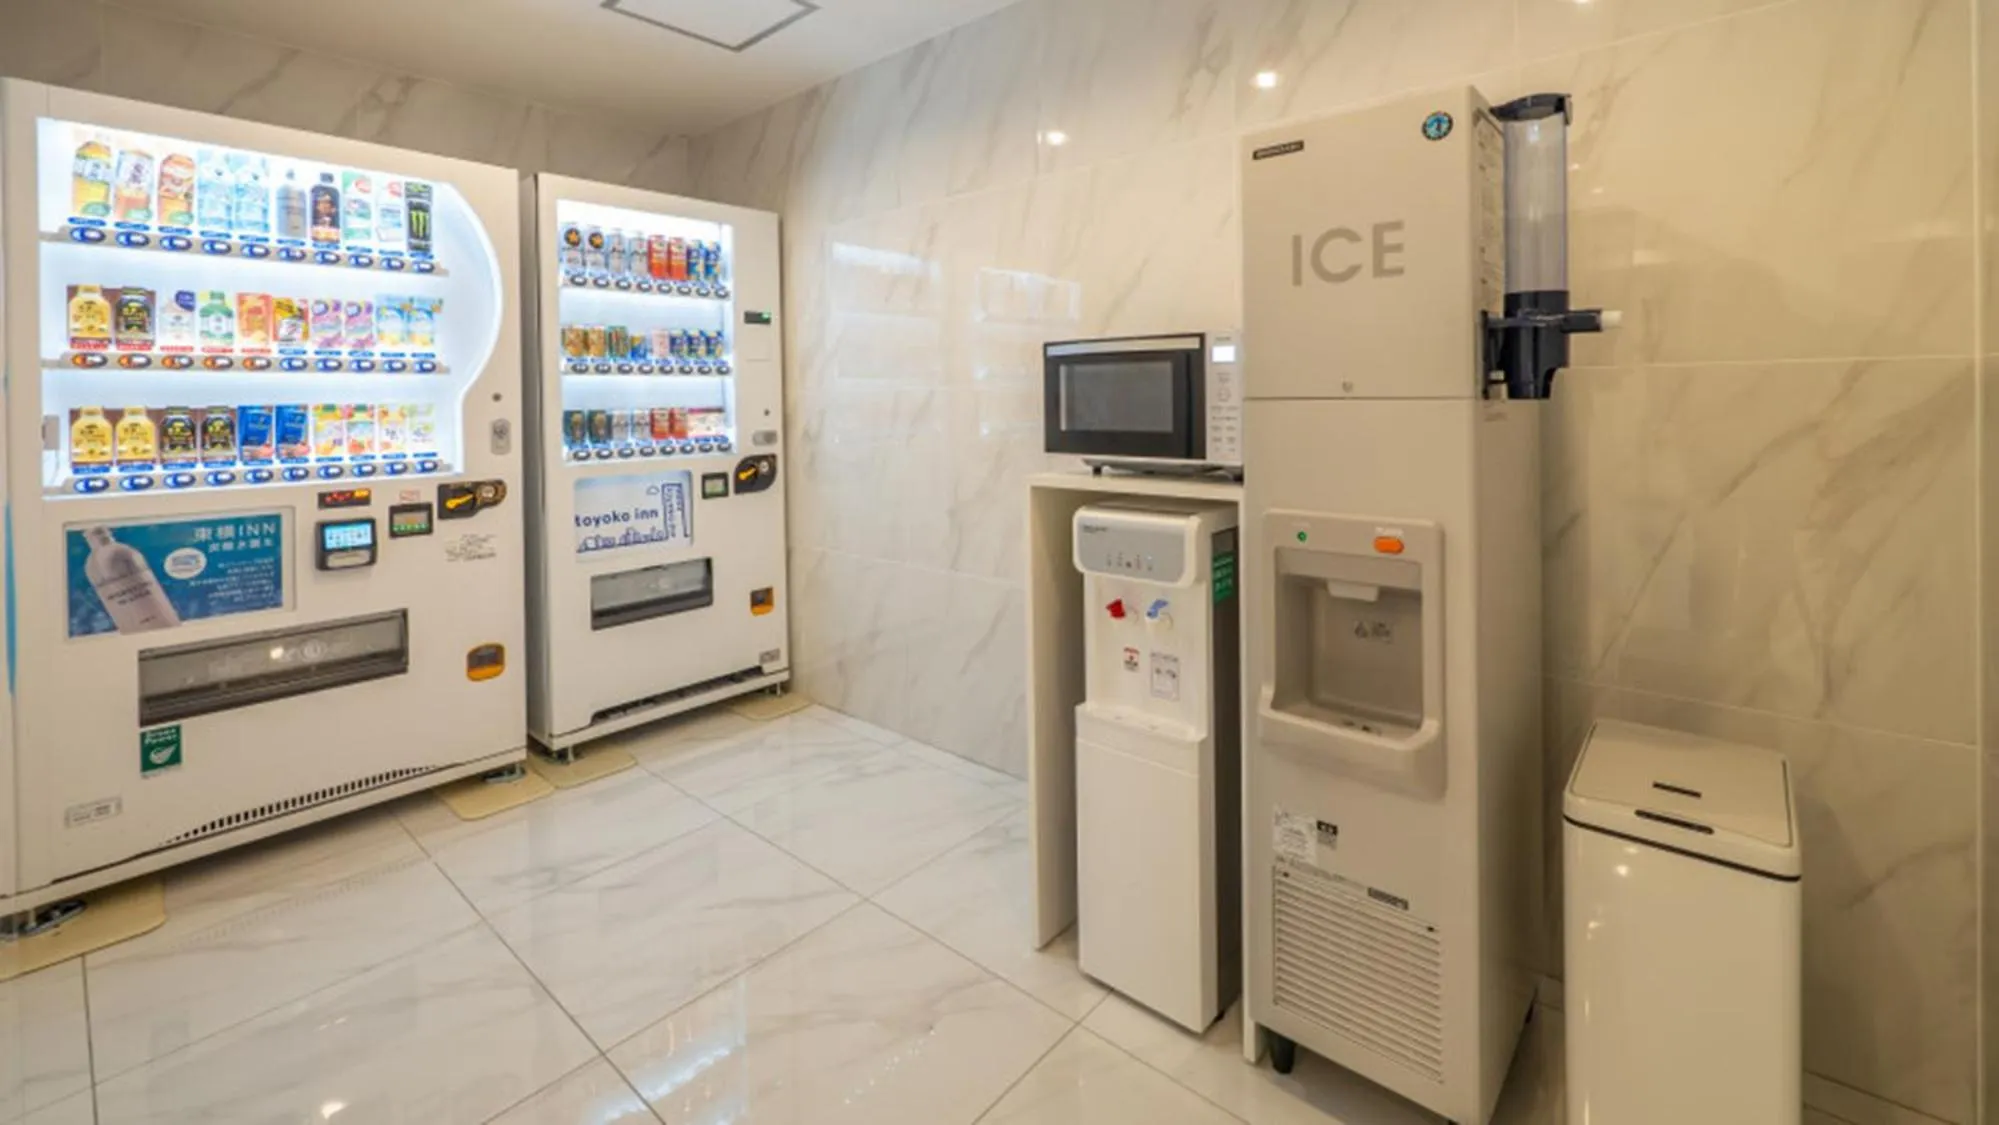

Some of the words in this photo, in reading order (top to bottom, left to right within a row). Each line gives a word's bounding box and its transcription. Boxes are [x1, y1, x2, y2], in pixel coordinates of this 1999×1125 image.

[1291, 219, 1405, 287] ICE
[575, 509, 630, 529] toyoko
[634, 507, 659, 522] inn
